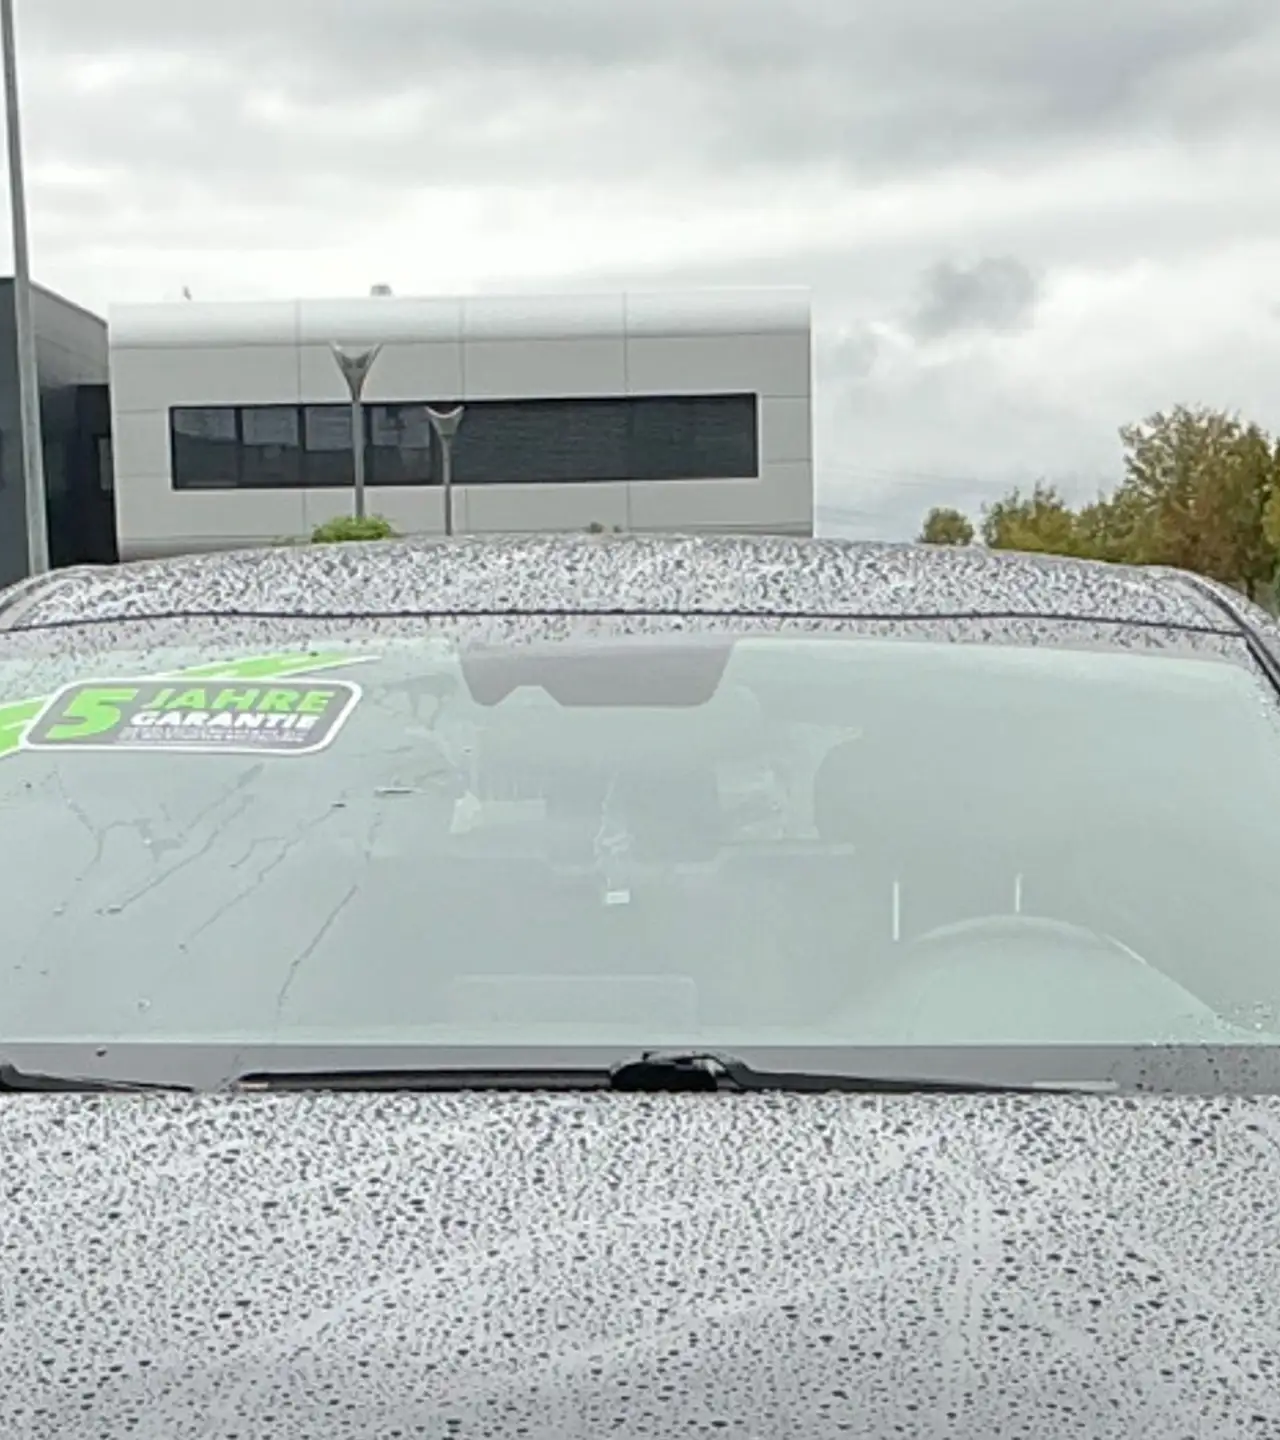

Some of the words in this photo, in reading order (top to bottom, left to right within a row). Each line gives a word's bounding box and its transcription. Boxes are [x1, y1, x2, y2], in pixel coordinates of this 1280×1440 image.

[45, 688, 140, 740] 5
[140, 688, 335, 713] JAHRE
[129, 711, 320, 730] GARANTIE
